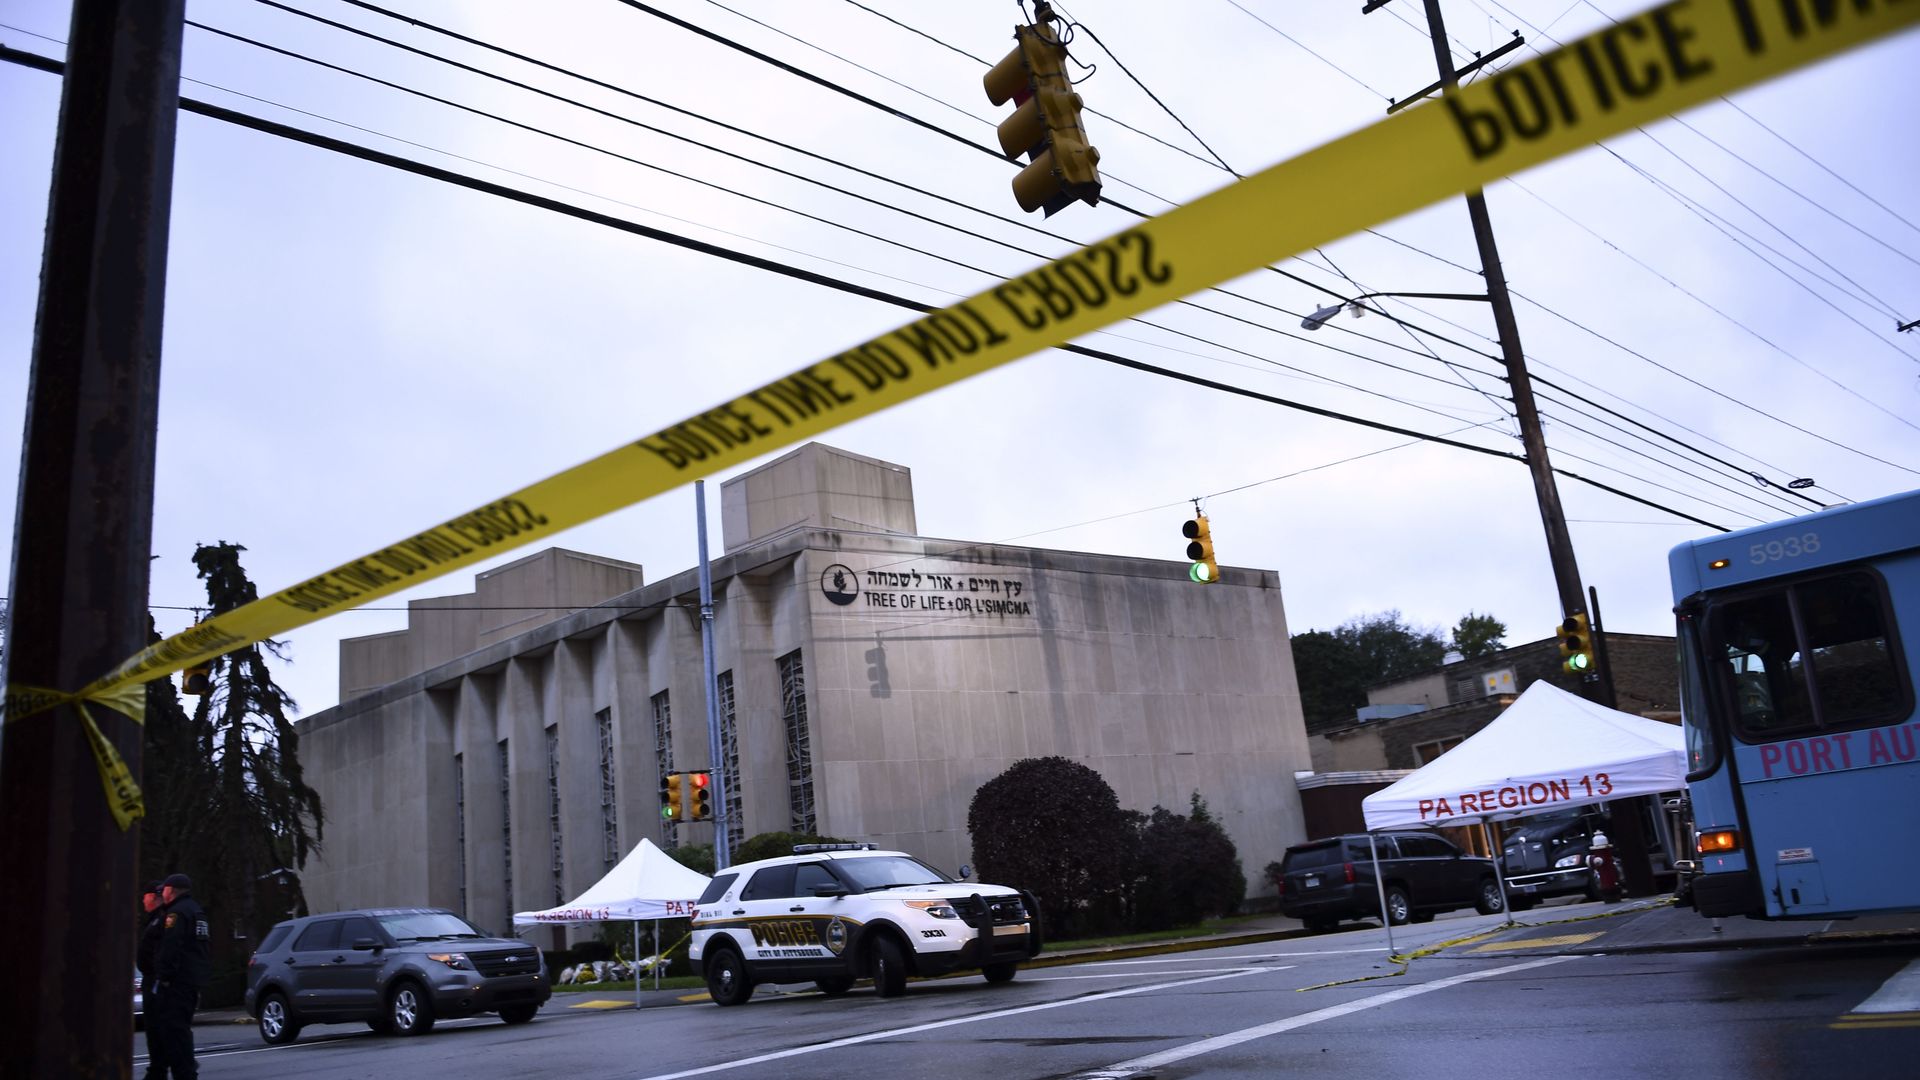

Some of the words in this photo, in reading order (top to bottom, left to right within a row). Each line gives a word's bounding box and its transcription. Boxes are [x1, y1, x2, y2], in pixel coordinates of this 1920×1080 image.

[1750, 533, 1821, 565] 5938
[867, 568, 922, 588] לשמחה
[926, 574, 953, 590] אור
[968, 578, 1000, 593] חיים
[1003, 580, 1023, 599] עץ
[864, 591, 897, 608] TREE
[900, 594, 916, 609] OF
[920, 595, 946, 611] LIFE
[955, 597, 972, 612] OR
[976, 598, 1031, 615] L'SIMCHA
[1759, 732, 1853, 779] PORT
[1418, 797, 1454, 820] PA
[1459, 778, 1570, 814] REGION
[1579, 773, 1614, 797] 13
[666, 901, 685, 915] PA
[749, 920, 821, 947] POLICE
[757, 949, 772, 958] CITY
[773, 949, 781, 957] OF
